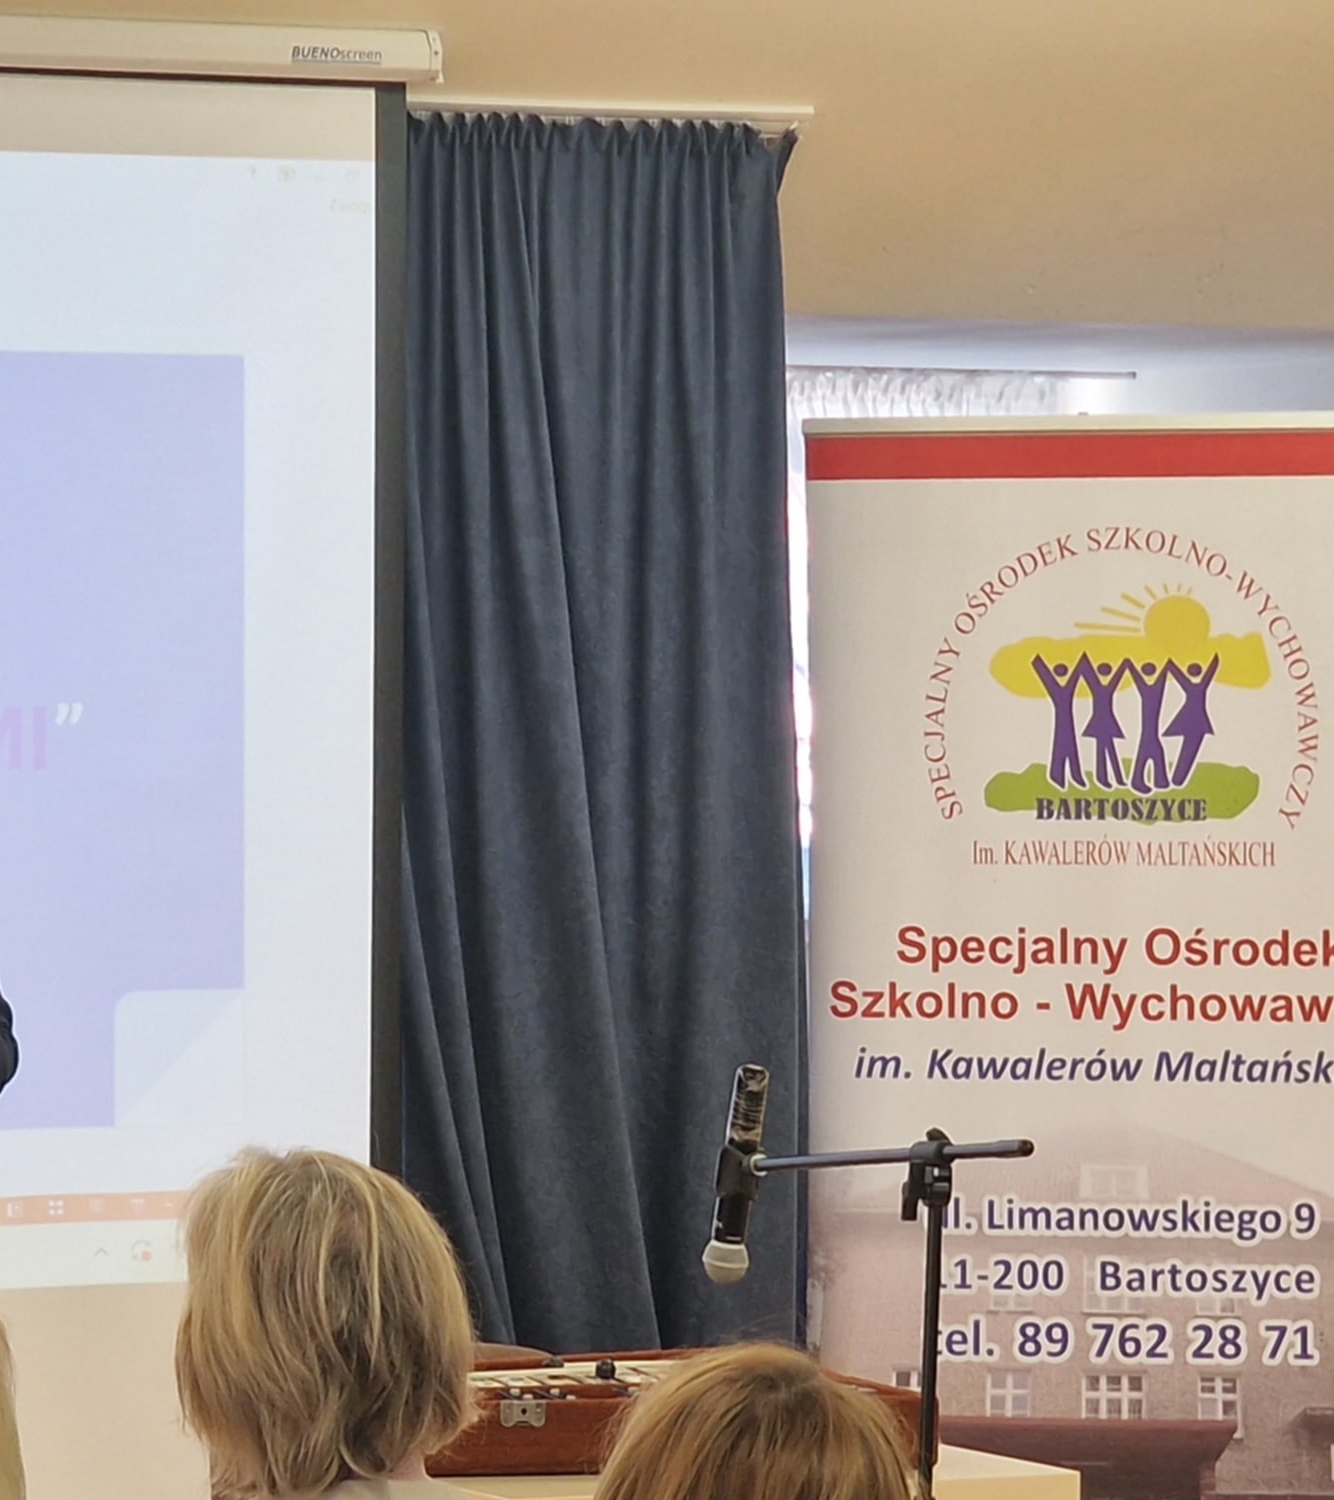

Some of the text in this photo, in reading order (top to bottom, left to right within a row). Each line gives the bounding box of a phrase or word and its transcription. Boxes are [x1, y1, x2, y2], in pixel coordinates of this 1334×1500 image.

[291, 45, 382, 62] BUENOscreen
[923, 636, 966, 822] SPECJALNY
[953, 533, 1079, 637] OŚRODEK
[1035, 797, 1207, 822] BARTOSZYCE
[972, 834, 1276, 868] Im. KAWALERÓW MALTAŃSKICH
[896, 925, 1128, 975] Specjalny
[829, 980, 1019, 1021] Szkolno
[853, 1047, 912, 1080] im.
[927, 1047, 1143, 1082] Kawalerów
[987, 1198, 1283, 1241] Limanowskiego
[1295, 1202, 1316, 1234] 9
[940, 1258, 1317, 1302] 1-200 Bartoszyce
[1017, 1322, 1069, 1358] 89
[1091, 1323, 1169, 1359] 762
[1190, 1324, 1243, 1360] 28
[1264, 1325, 1315, 1361] 71
